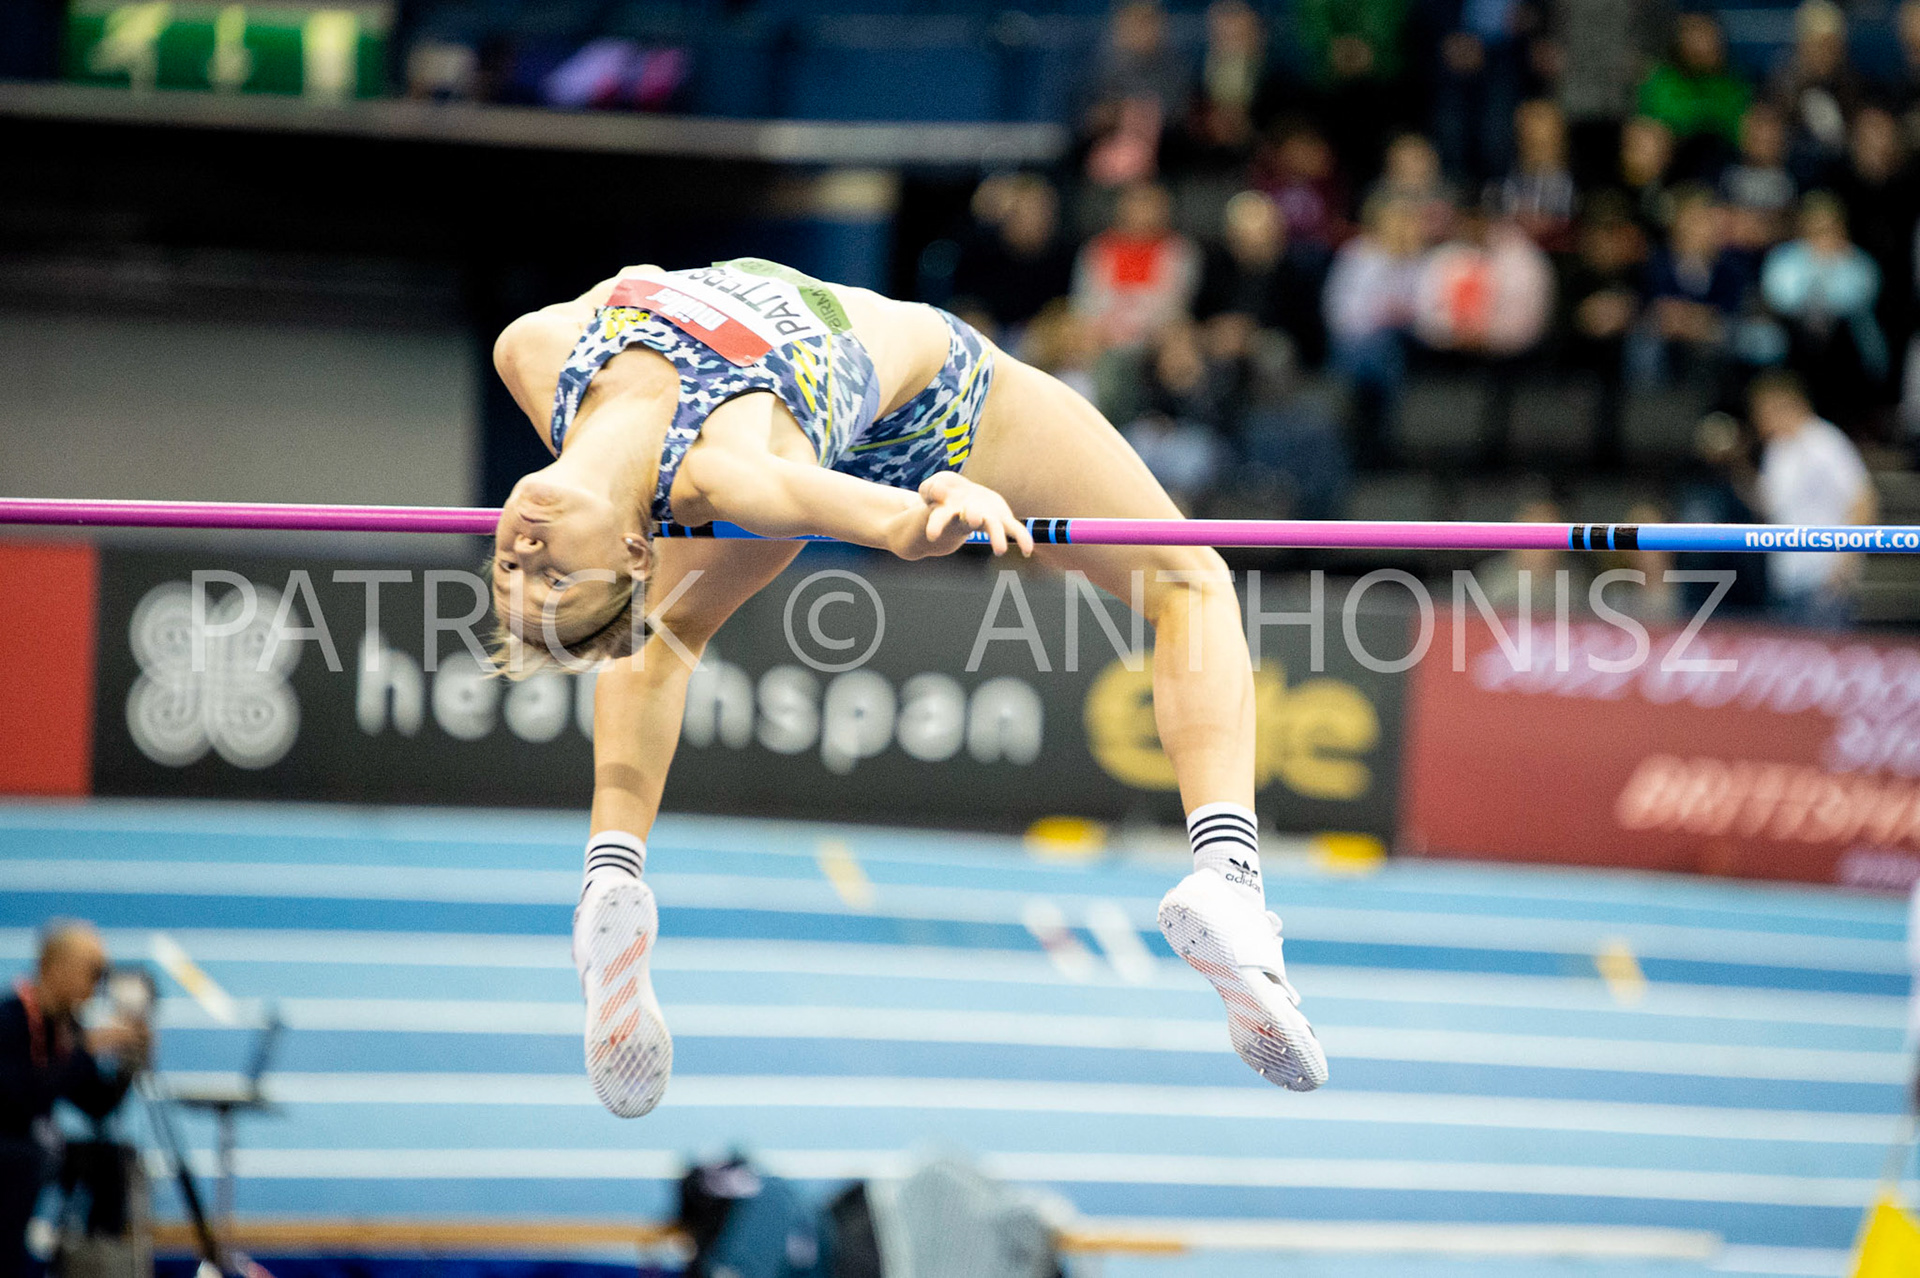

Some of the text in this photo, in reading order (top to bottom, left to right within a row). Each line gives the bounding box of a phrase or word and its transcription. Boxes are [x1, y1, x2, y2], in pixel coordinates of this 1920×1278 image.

[687, 266, 812, 336] PATTERS
[1745, 527, 1919, 551] nordicsport.co
[357, 627, 1043, 775] heahspan
